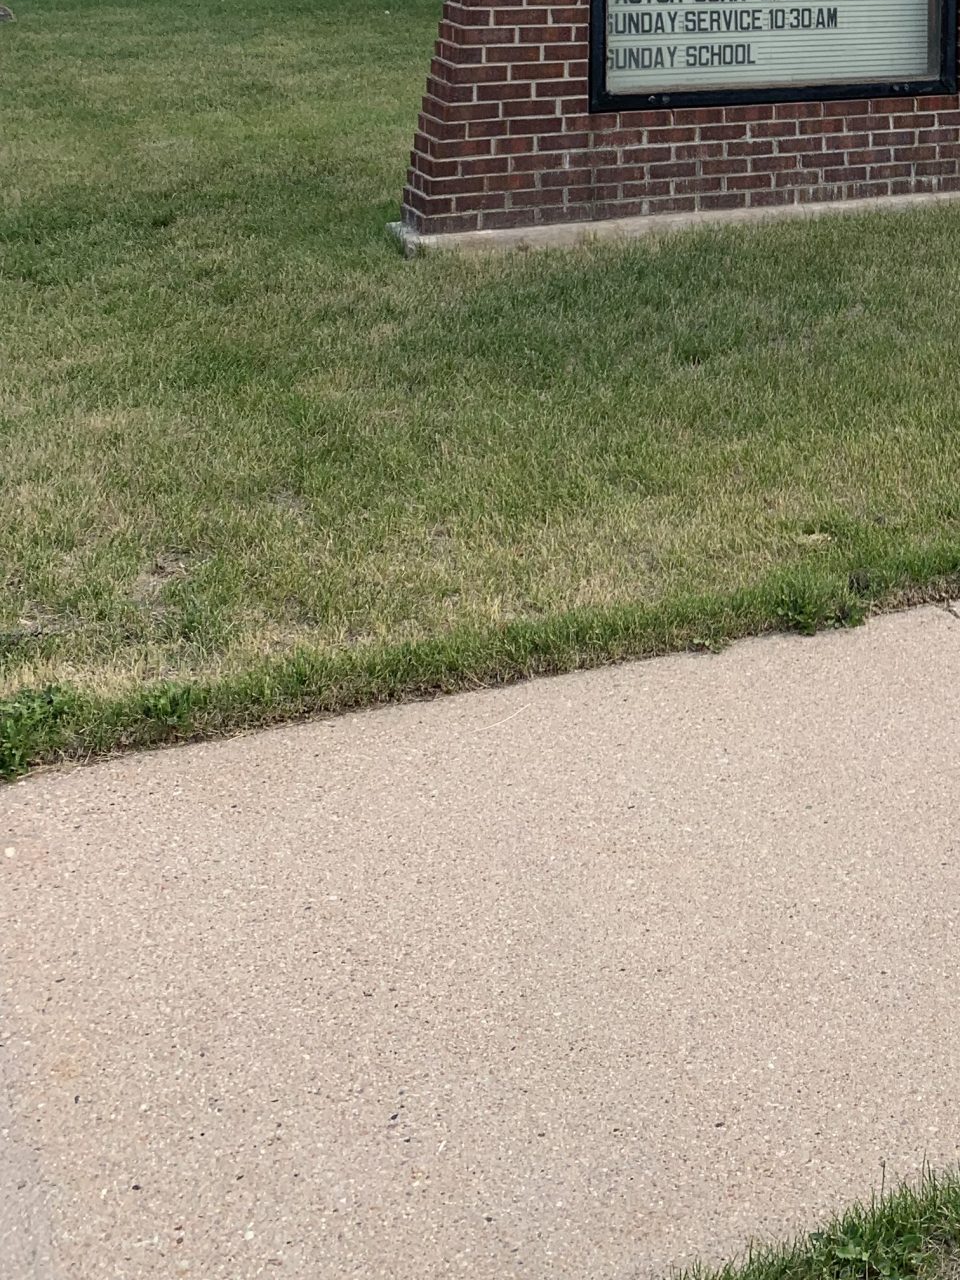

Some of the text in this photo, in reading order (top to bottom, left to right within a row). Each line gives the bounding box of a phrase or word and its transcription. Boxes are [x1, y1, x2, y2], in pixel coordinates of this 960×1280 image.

[685, 10, 762, 32] SERVICE
[815, 8, 837, 28] AM
[686, 44, 756, 66] SCHOOL
